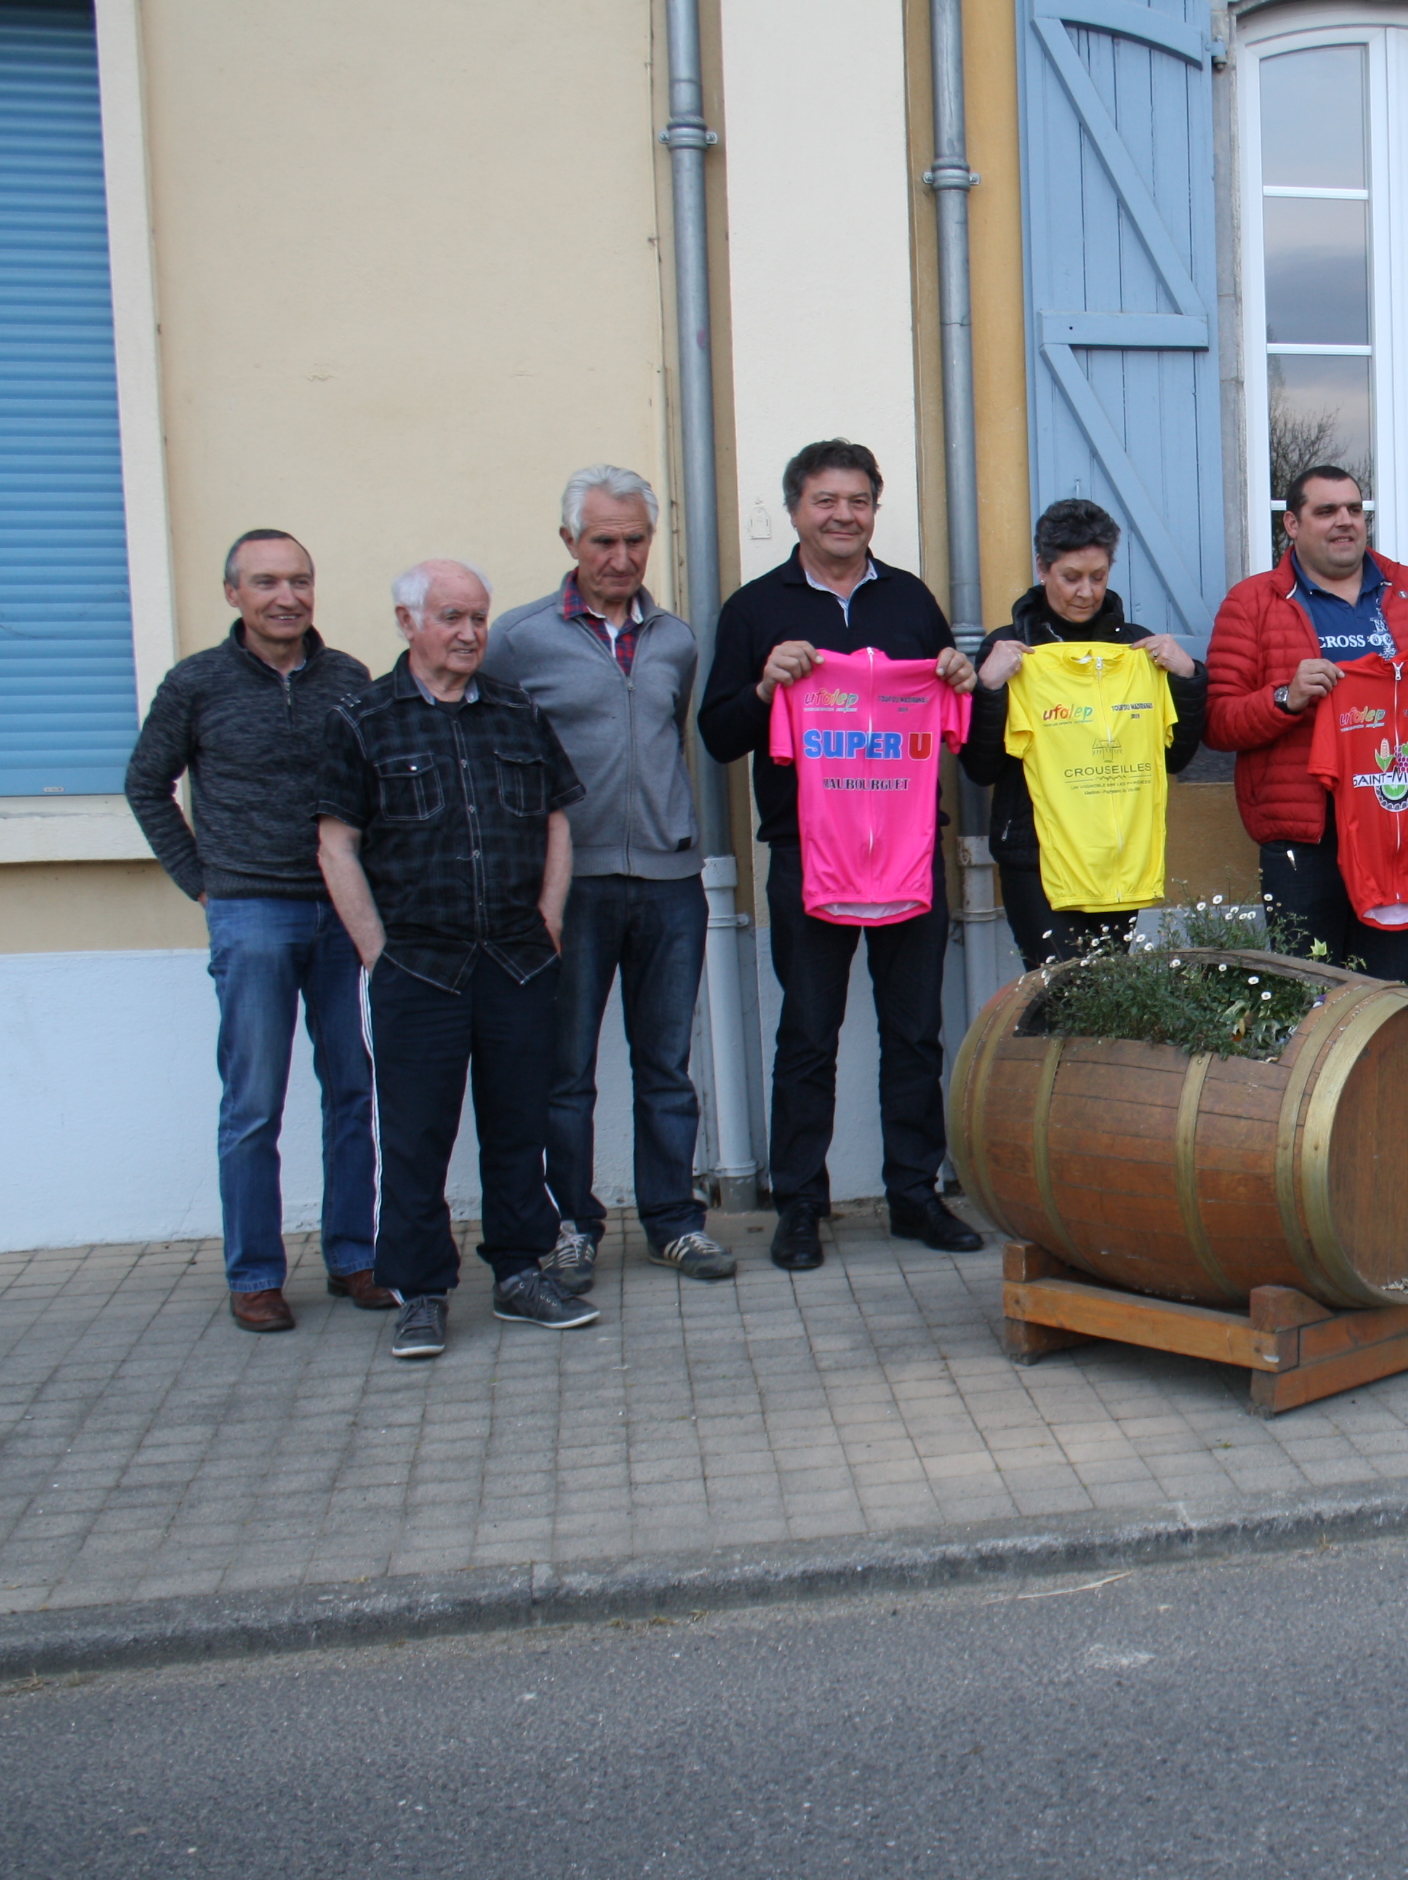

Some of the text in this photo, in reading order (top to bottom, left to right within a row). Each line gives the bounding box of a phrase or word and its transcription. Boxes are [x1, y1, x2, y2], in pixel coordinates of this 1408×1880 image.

[1318, 634, 1366, 649] CROSS
[1043, 703, 1093, 721] ufolep
[1340, 706, 1386, 727] ufolep
[803, 729, 933, 761] SUPER U
[1064, 763, 1152, 778] CROUSEILLES
